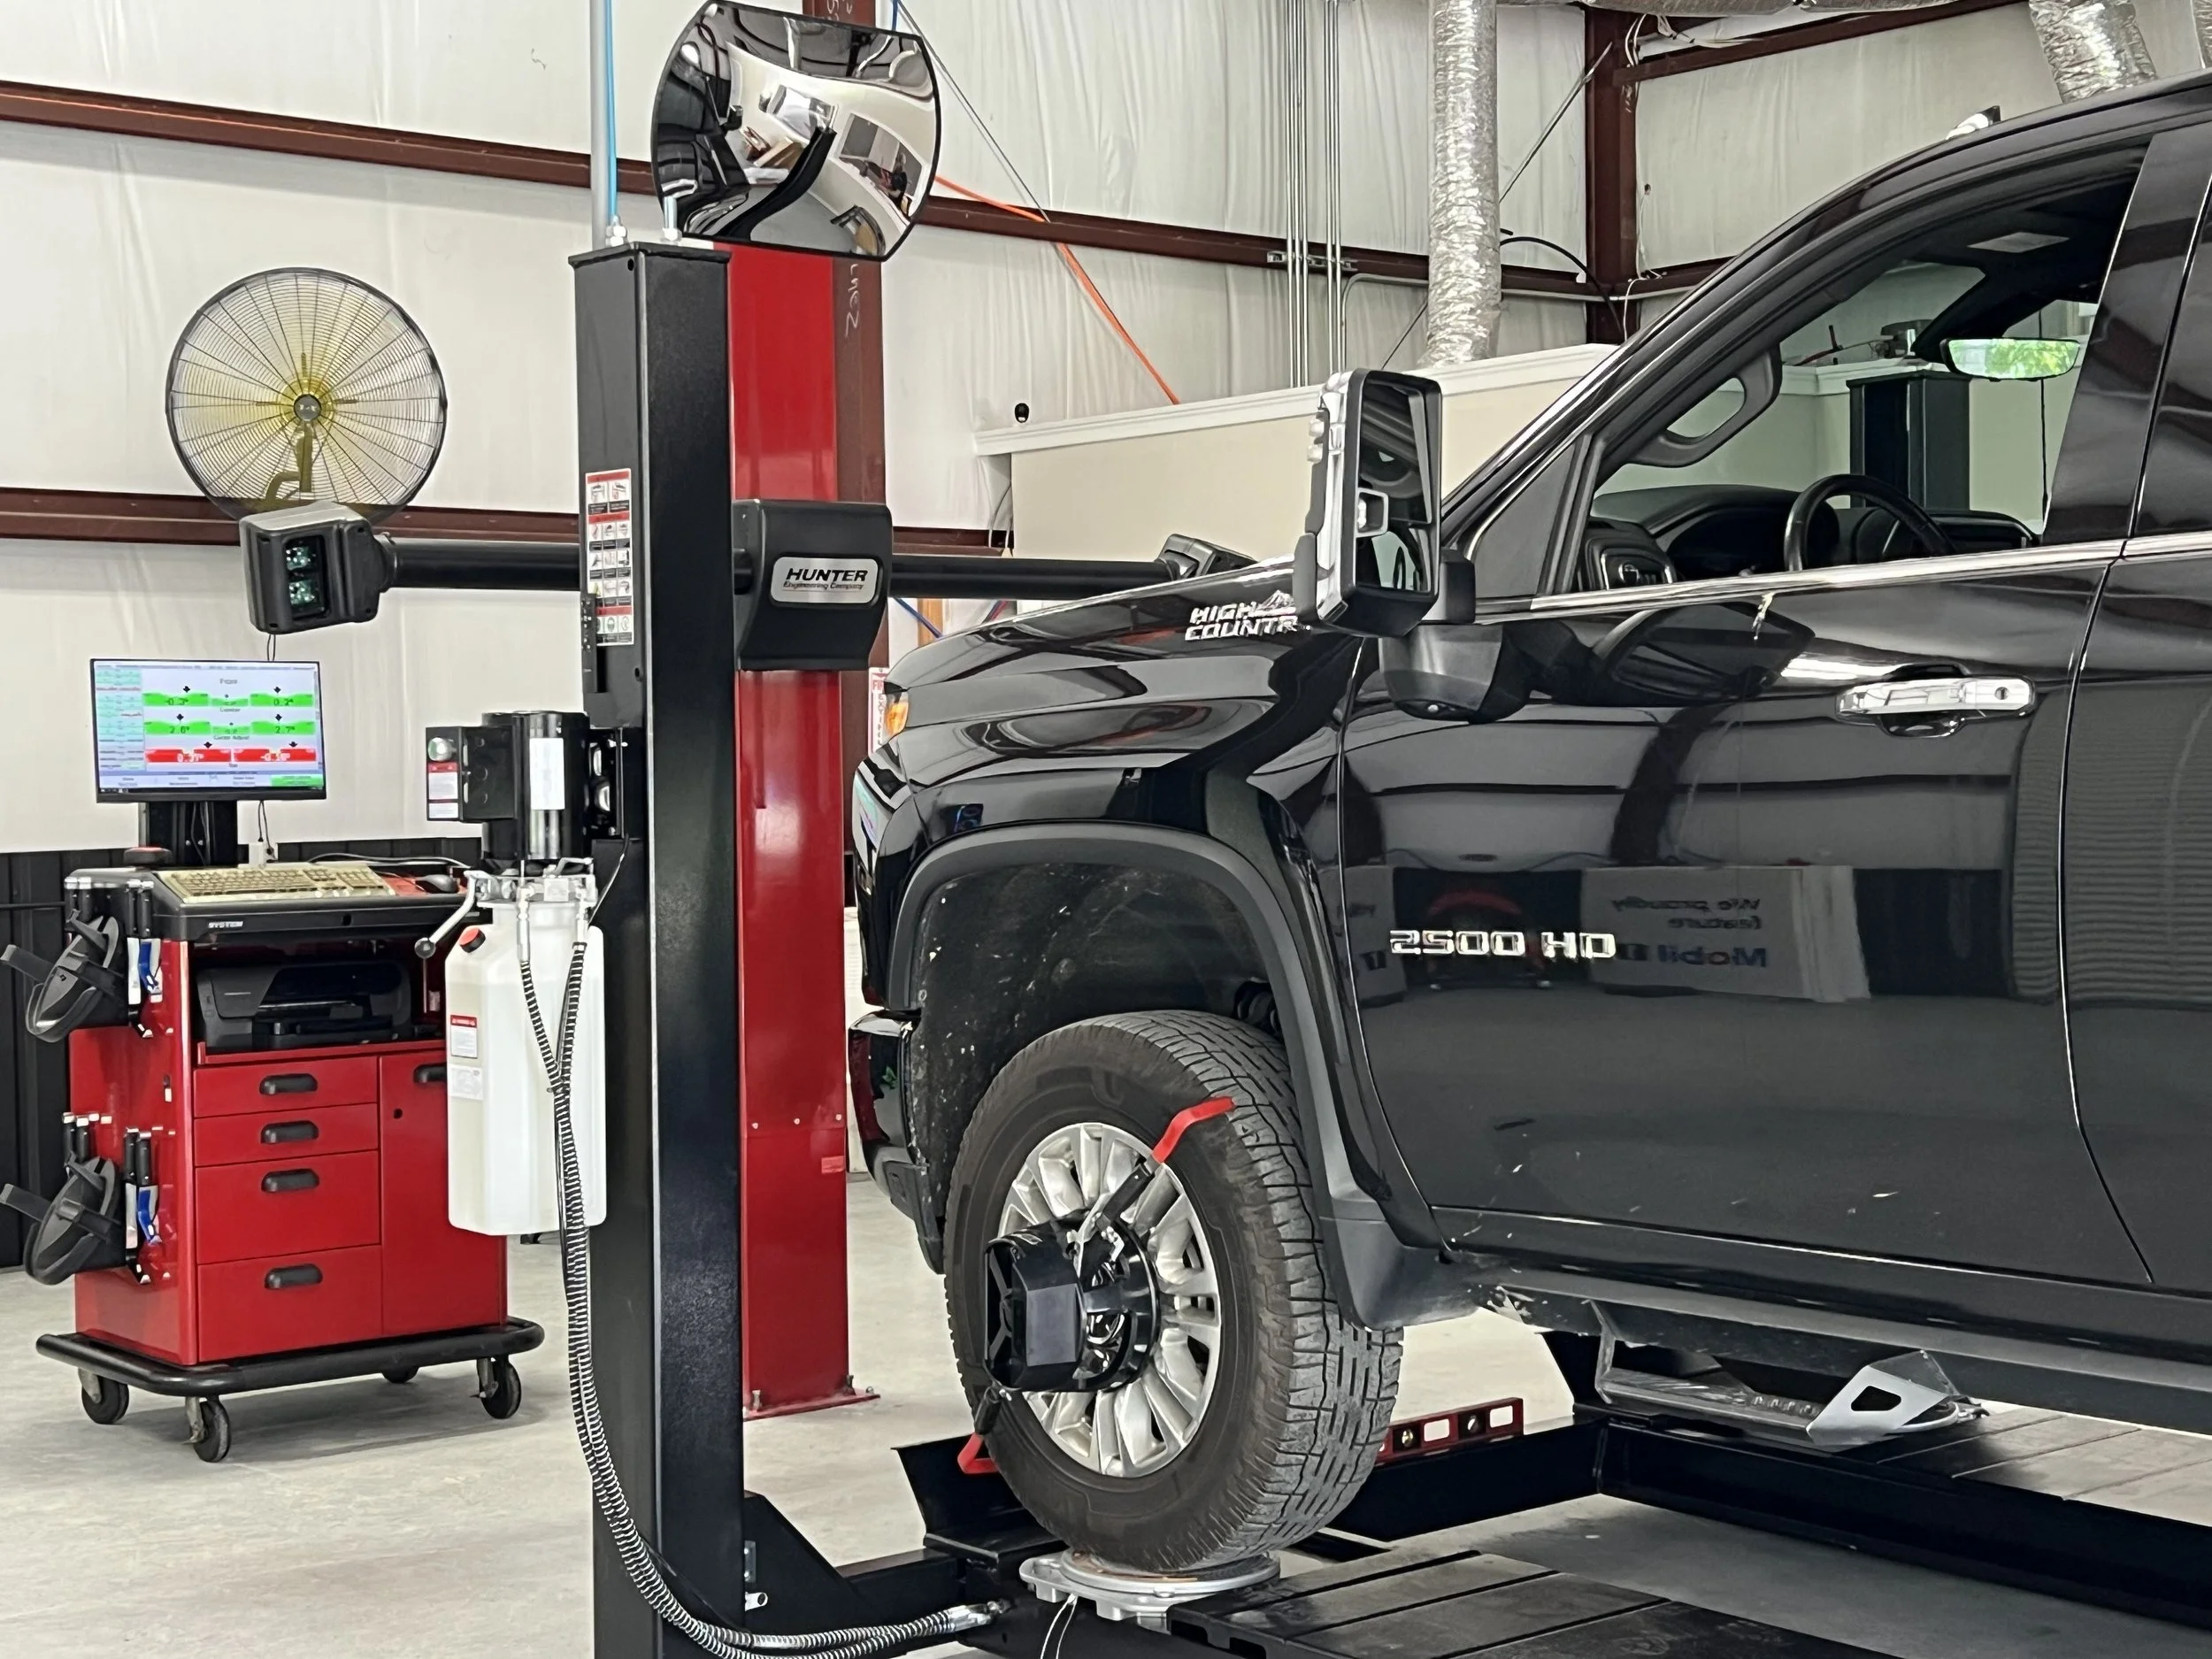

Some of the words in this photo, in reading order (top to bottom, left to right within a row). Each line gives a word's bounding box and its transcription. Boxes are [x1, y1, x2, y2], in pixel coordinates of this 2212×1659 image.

[783, 580, 829, 590] Engineering
[786, 568, 868, 581] HUNTER
[1189, 602, 1257, 625] HIGH
[1185, 615, 1299, 641] COUNTR
[1390, 930, 1526, 956] 2500
[1540, 932, 1617, 959] HD
